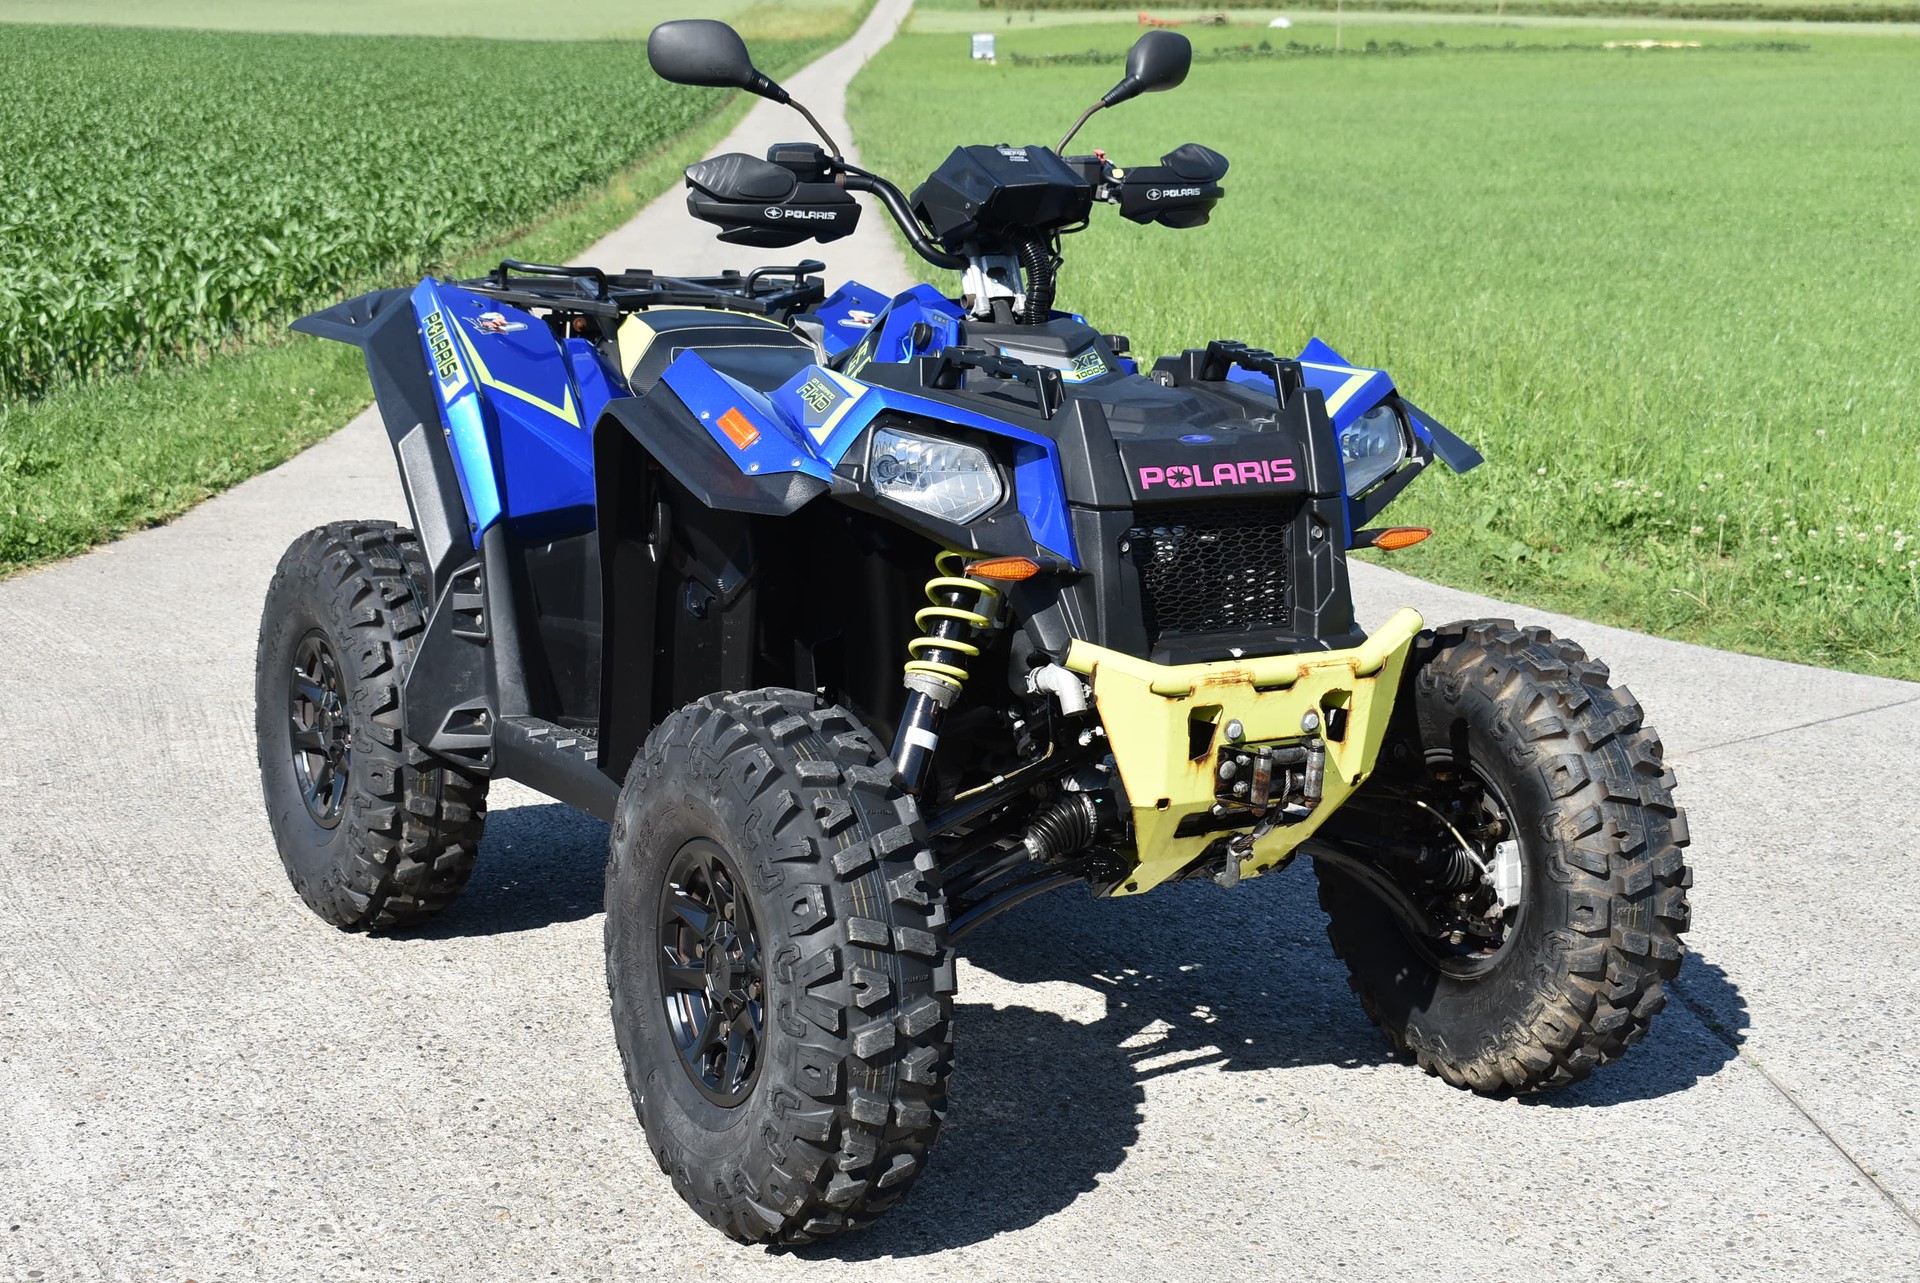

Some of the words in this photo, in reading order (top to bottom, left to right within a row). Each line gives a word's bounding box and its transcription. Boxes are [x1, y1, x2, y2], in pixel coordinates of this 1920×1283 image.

[1163, 188, 1201, 197] POLARIS
[785, 205, 837, 220] POLARIS
[422, 311, 458, 379] POLARIS
[1072, 352, 1100, 371] XP
[796, 381, 831, 413] AWD
[1139, 459, 1296, 490] POLARIS
